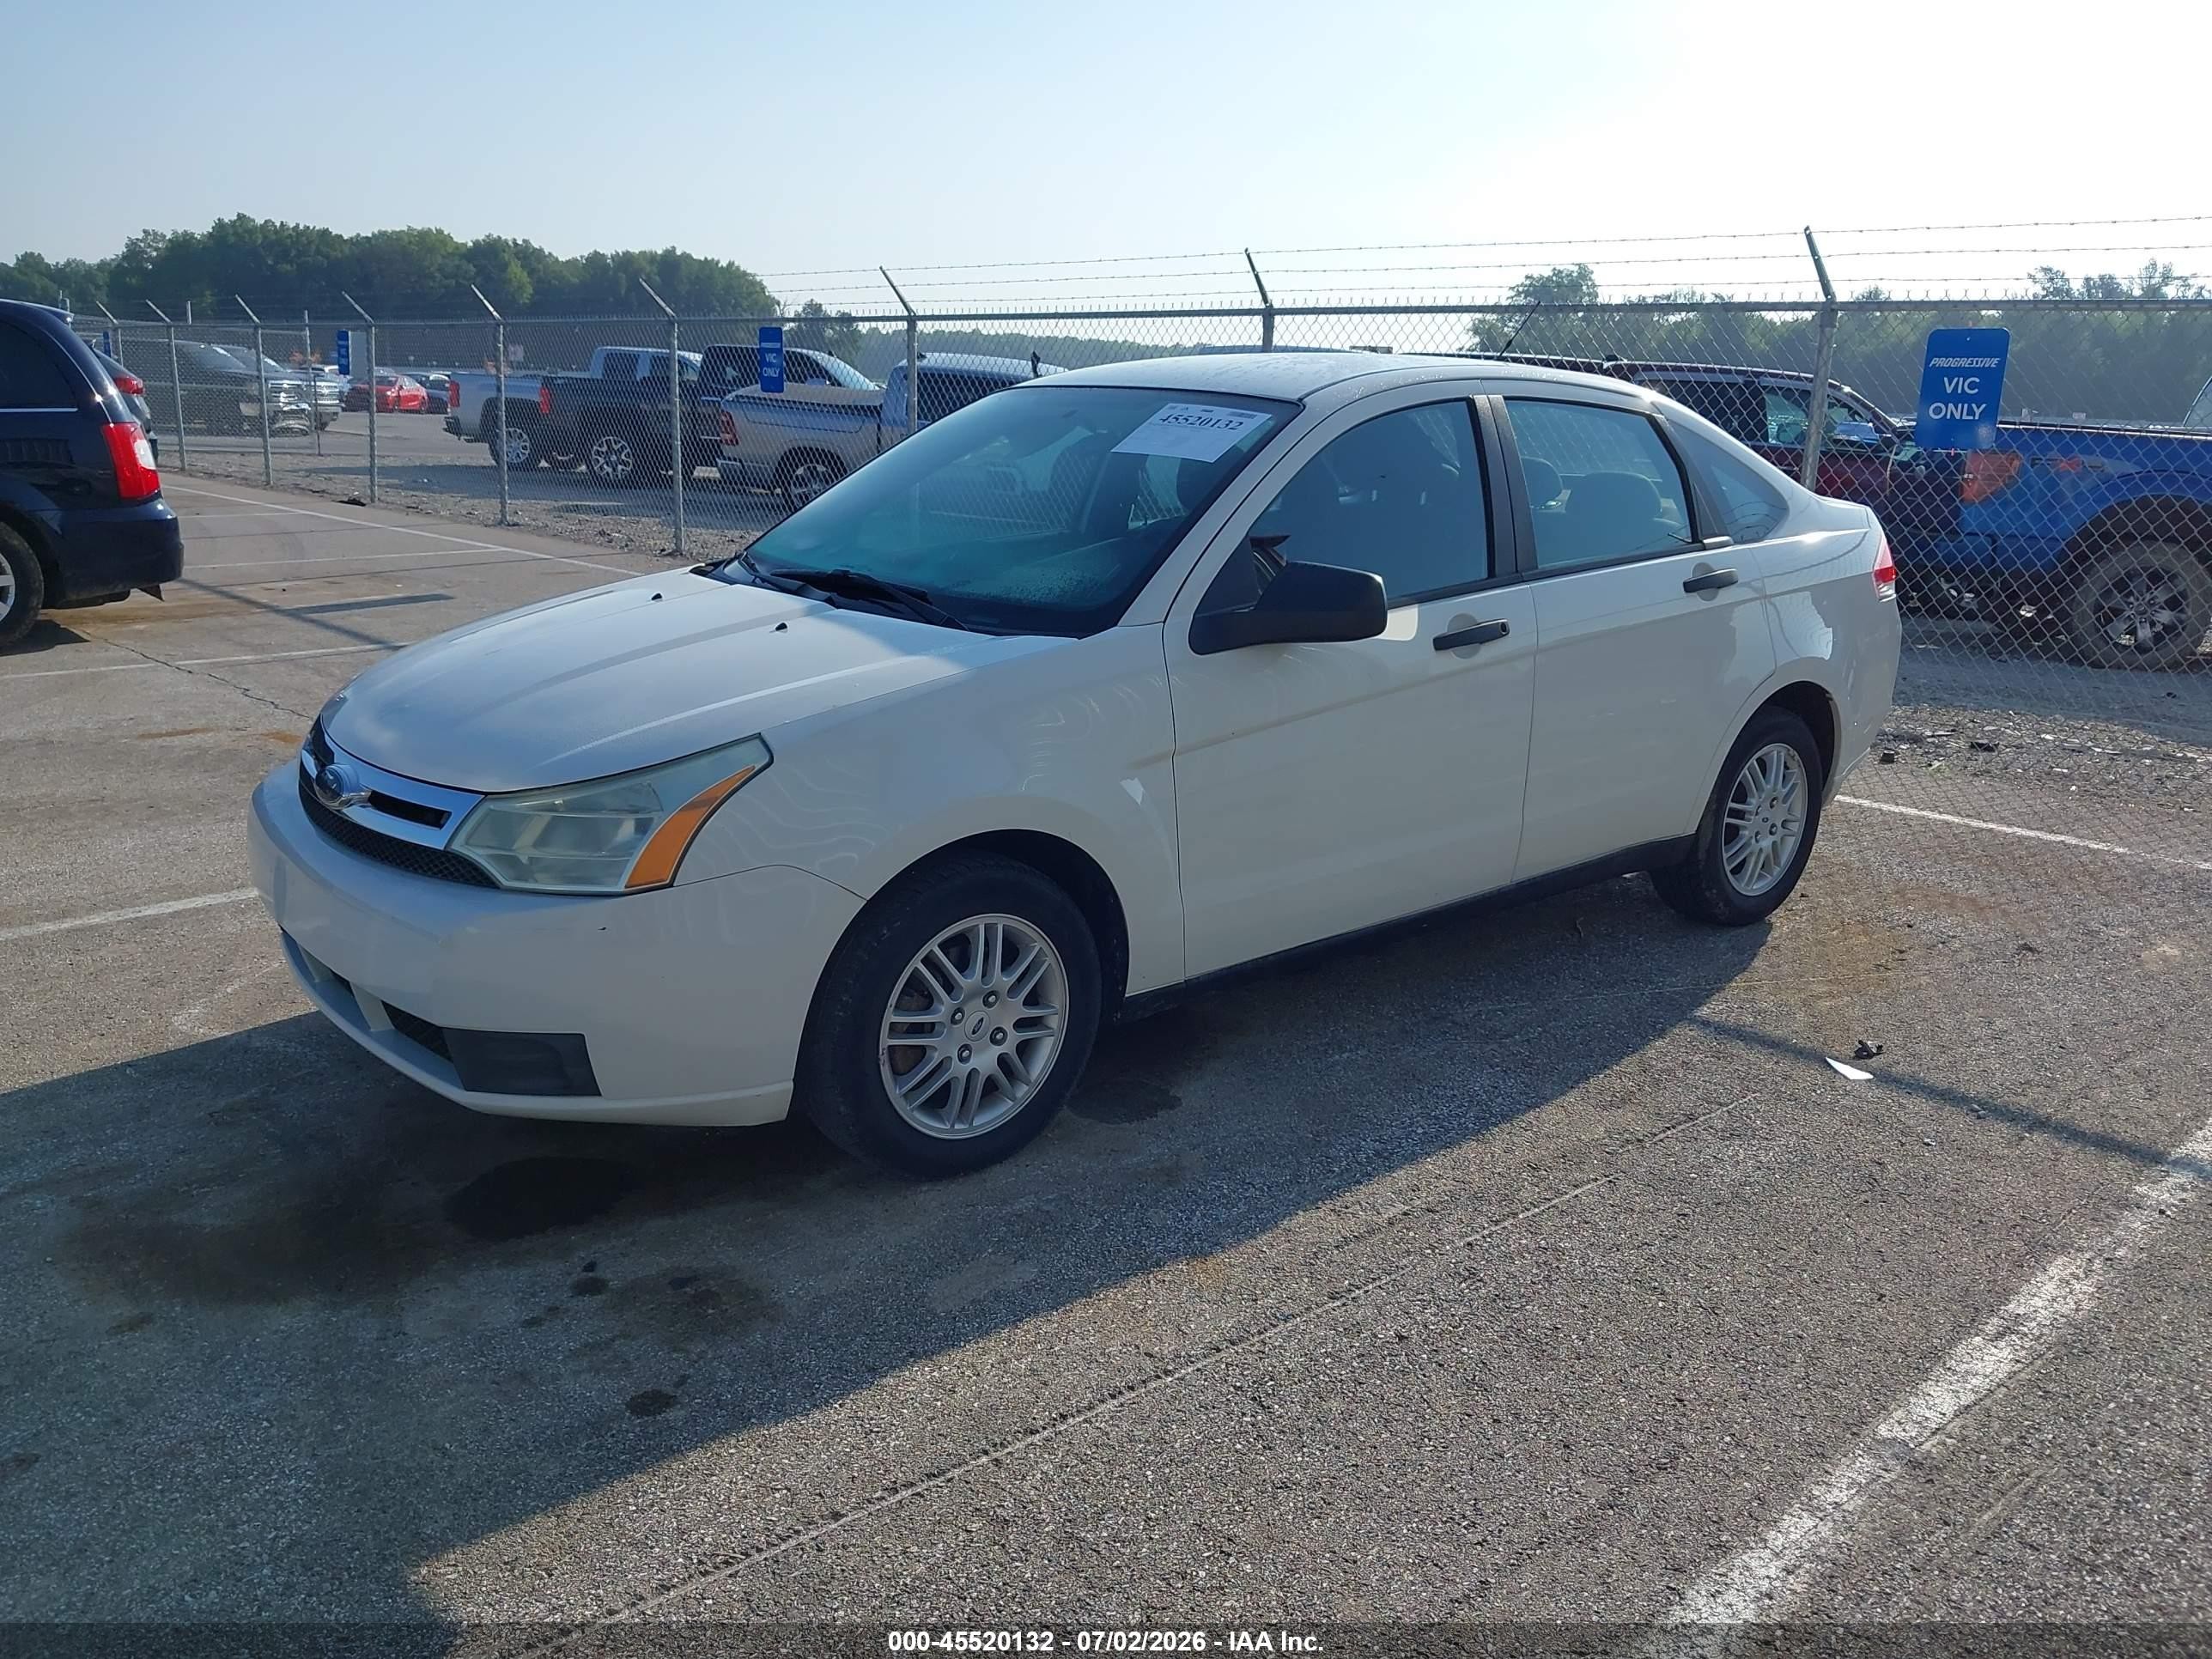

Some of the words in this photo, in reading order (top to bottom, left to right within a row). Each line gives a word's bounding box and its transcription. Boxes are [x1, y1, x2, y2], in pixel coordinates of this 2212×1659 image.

[764, 353, 777, 363] VIC
[1929, 357, 2001, 368] PROGRESSIVE
[763, 367, 781, 378] ONLY
[1943, 376, 1980, 394] VIC
[1929, 402, 1987, 420] ONLY
[1159, 414, 1243, 430] 45520132
